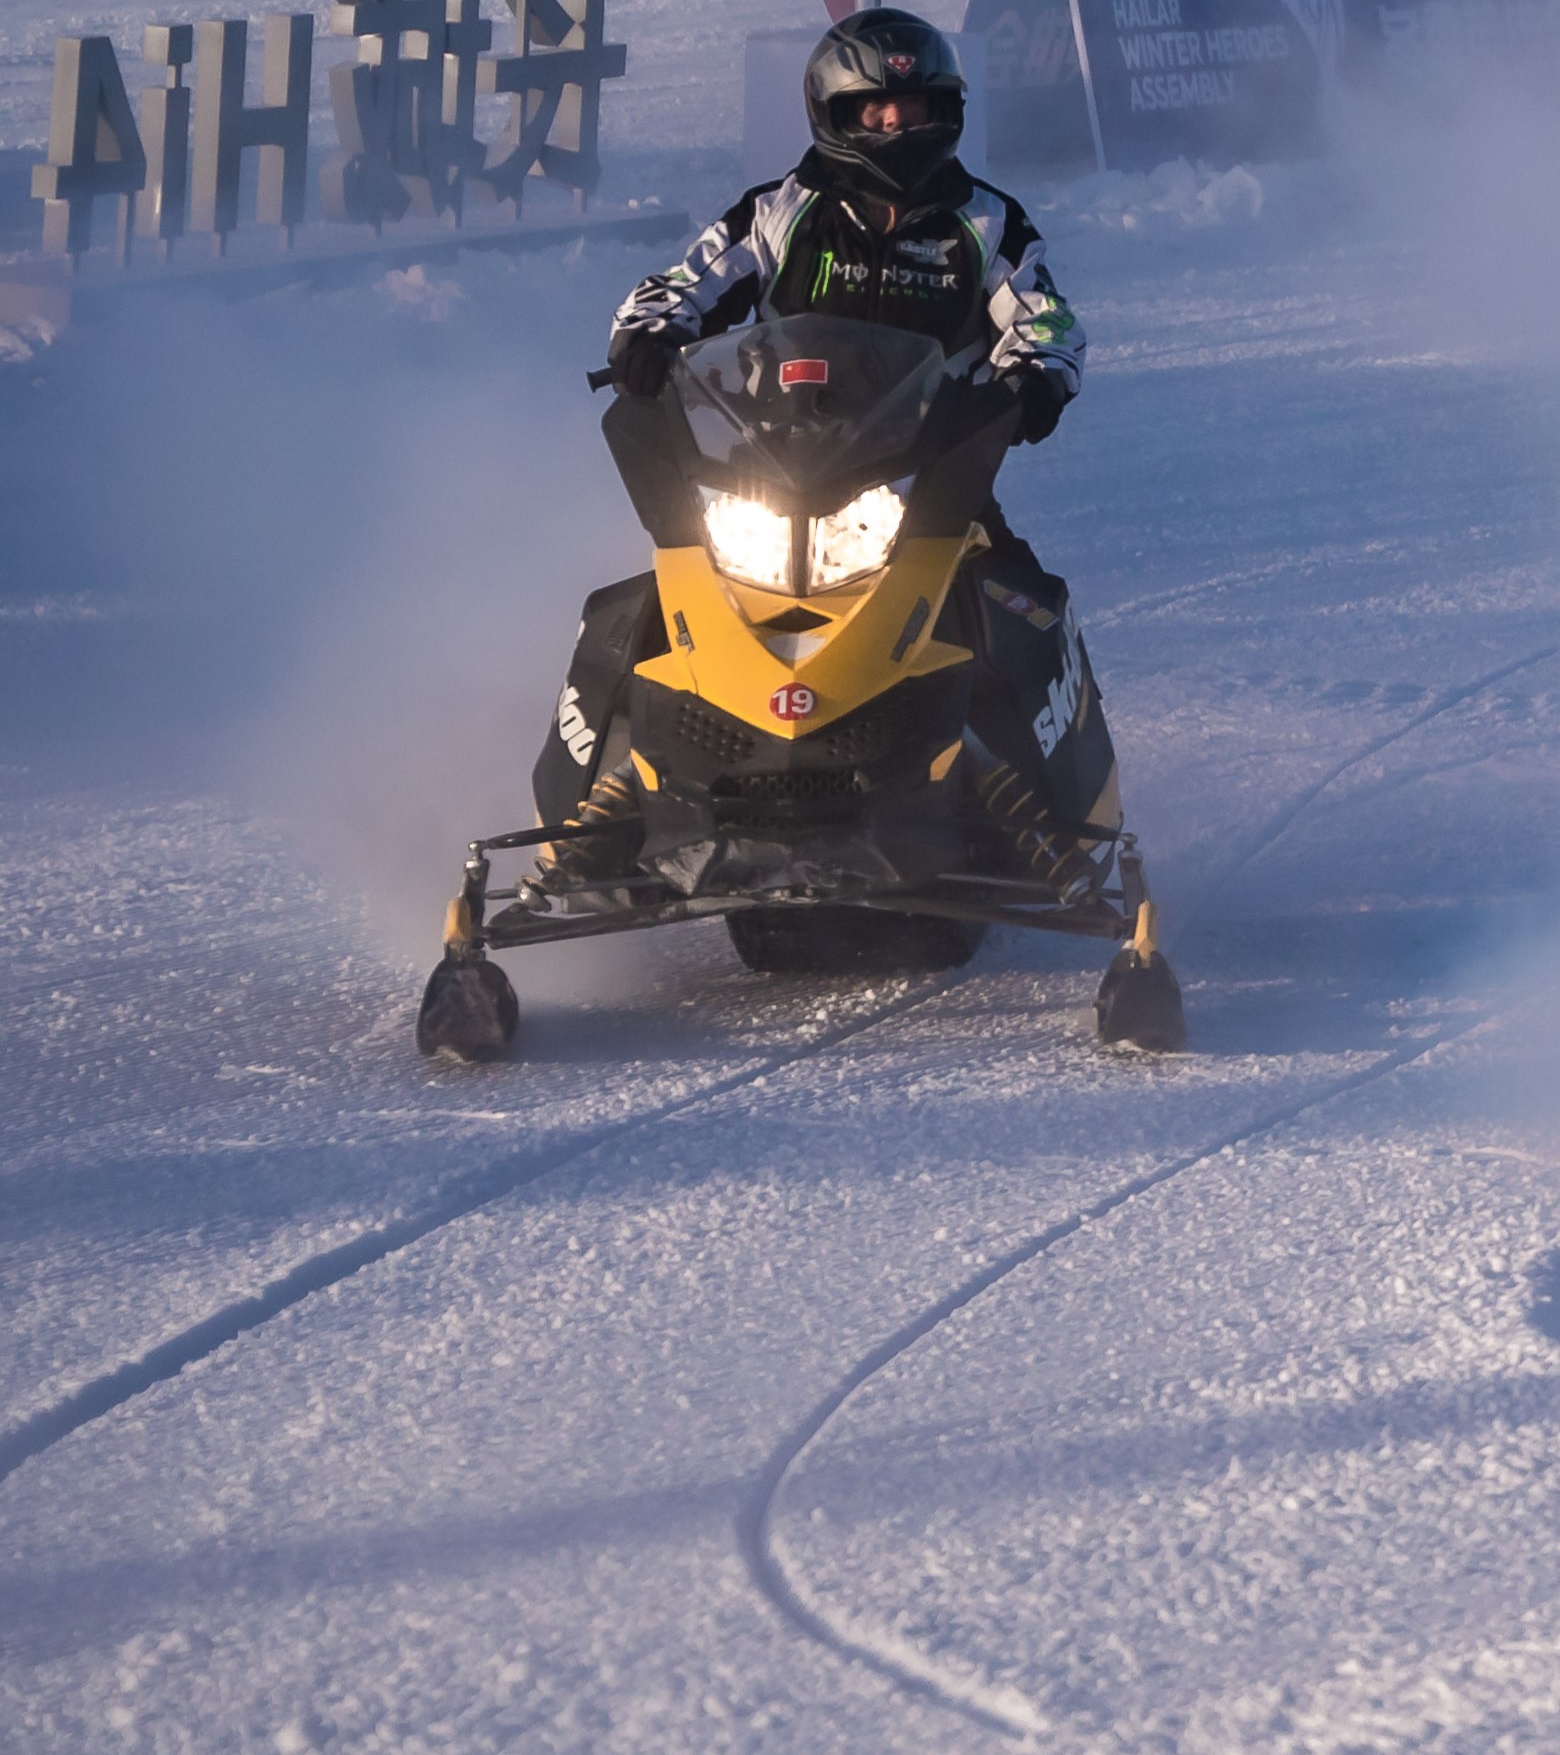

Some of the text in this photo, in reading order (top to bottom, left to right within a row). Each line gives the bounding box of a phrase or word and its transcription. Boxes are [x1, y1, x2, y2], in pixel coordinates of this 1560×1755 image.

[1117, 30, 1205, 71] WINTER
[1205, 24, 1290, 63] HEROES
[1129, 69, 1237, 113] ASSEMBLY
[771, 689, 815, 715] 19
